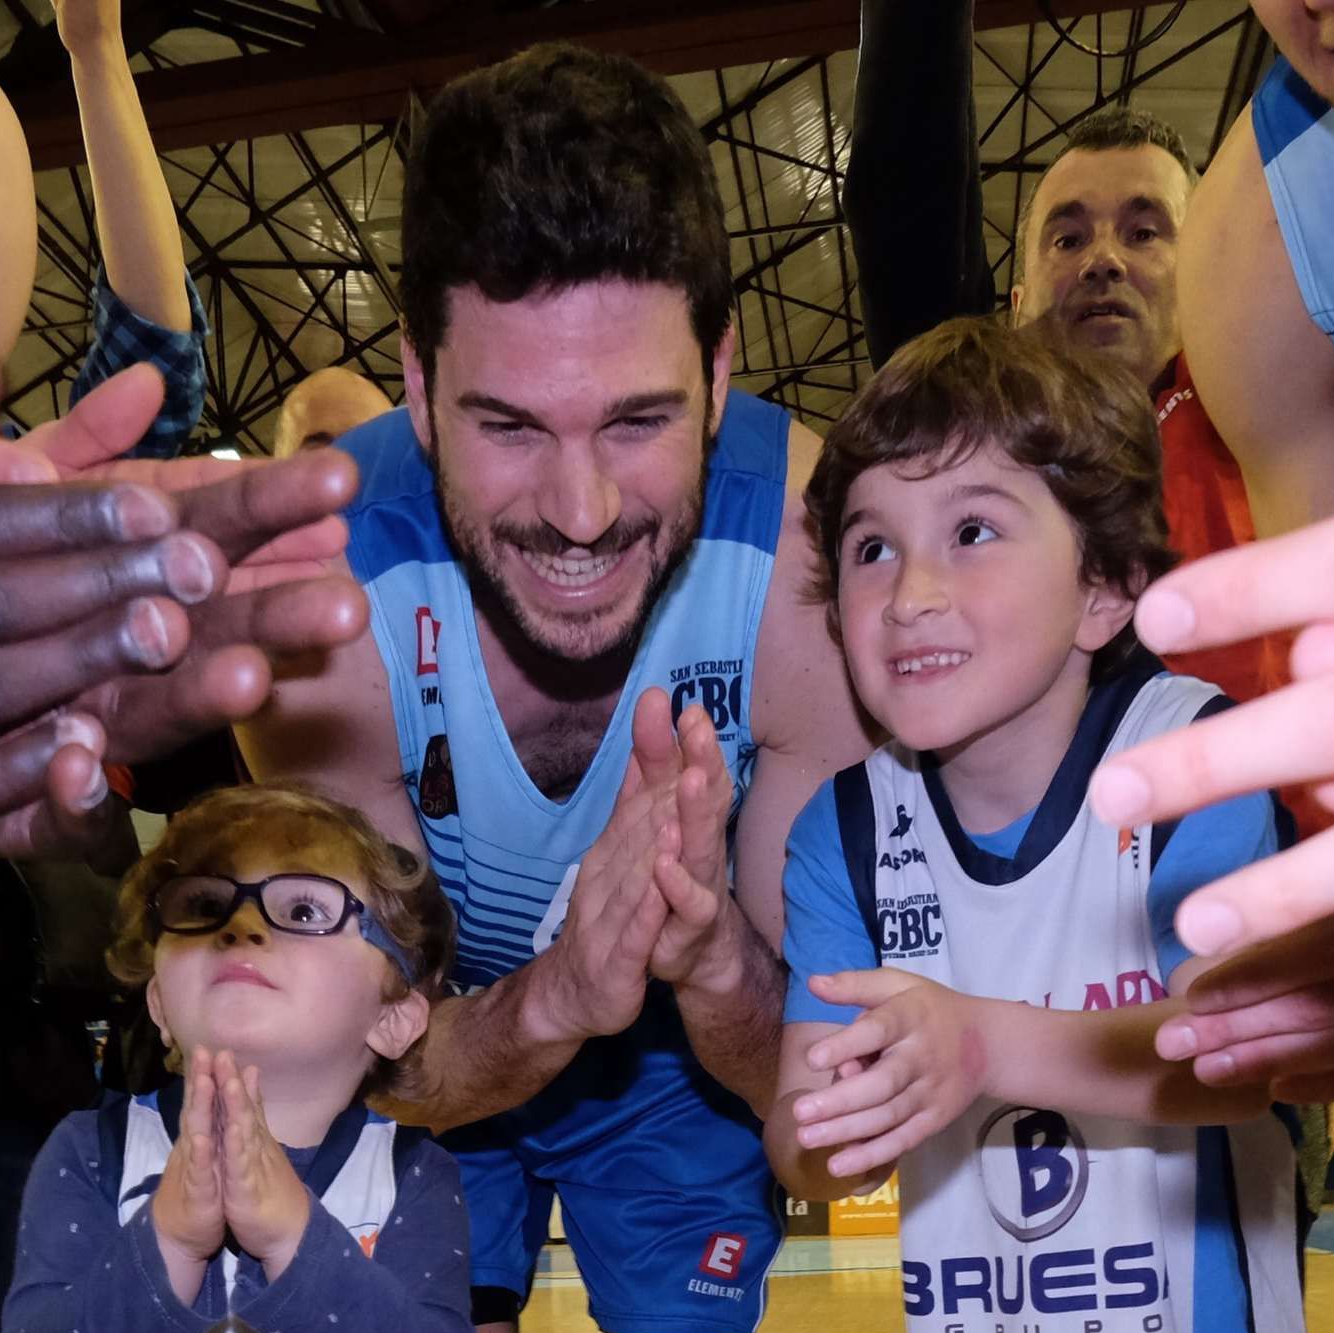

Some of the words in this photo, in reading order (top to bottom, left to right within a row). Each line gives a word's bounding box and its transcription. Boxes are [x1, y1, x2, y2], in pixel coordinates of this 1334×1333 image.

[878, 904, 943, 952] GBC
[785, 1197, 809, 1217] ta
[902, 1242, 1170, 1317] BRUES
